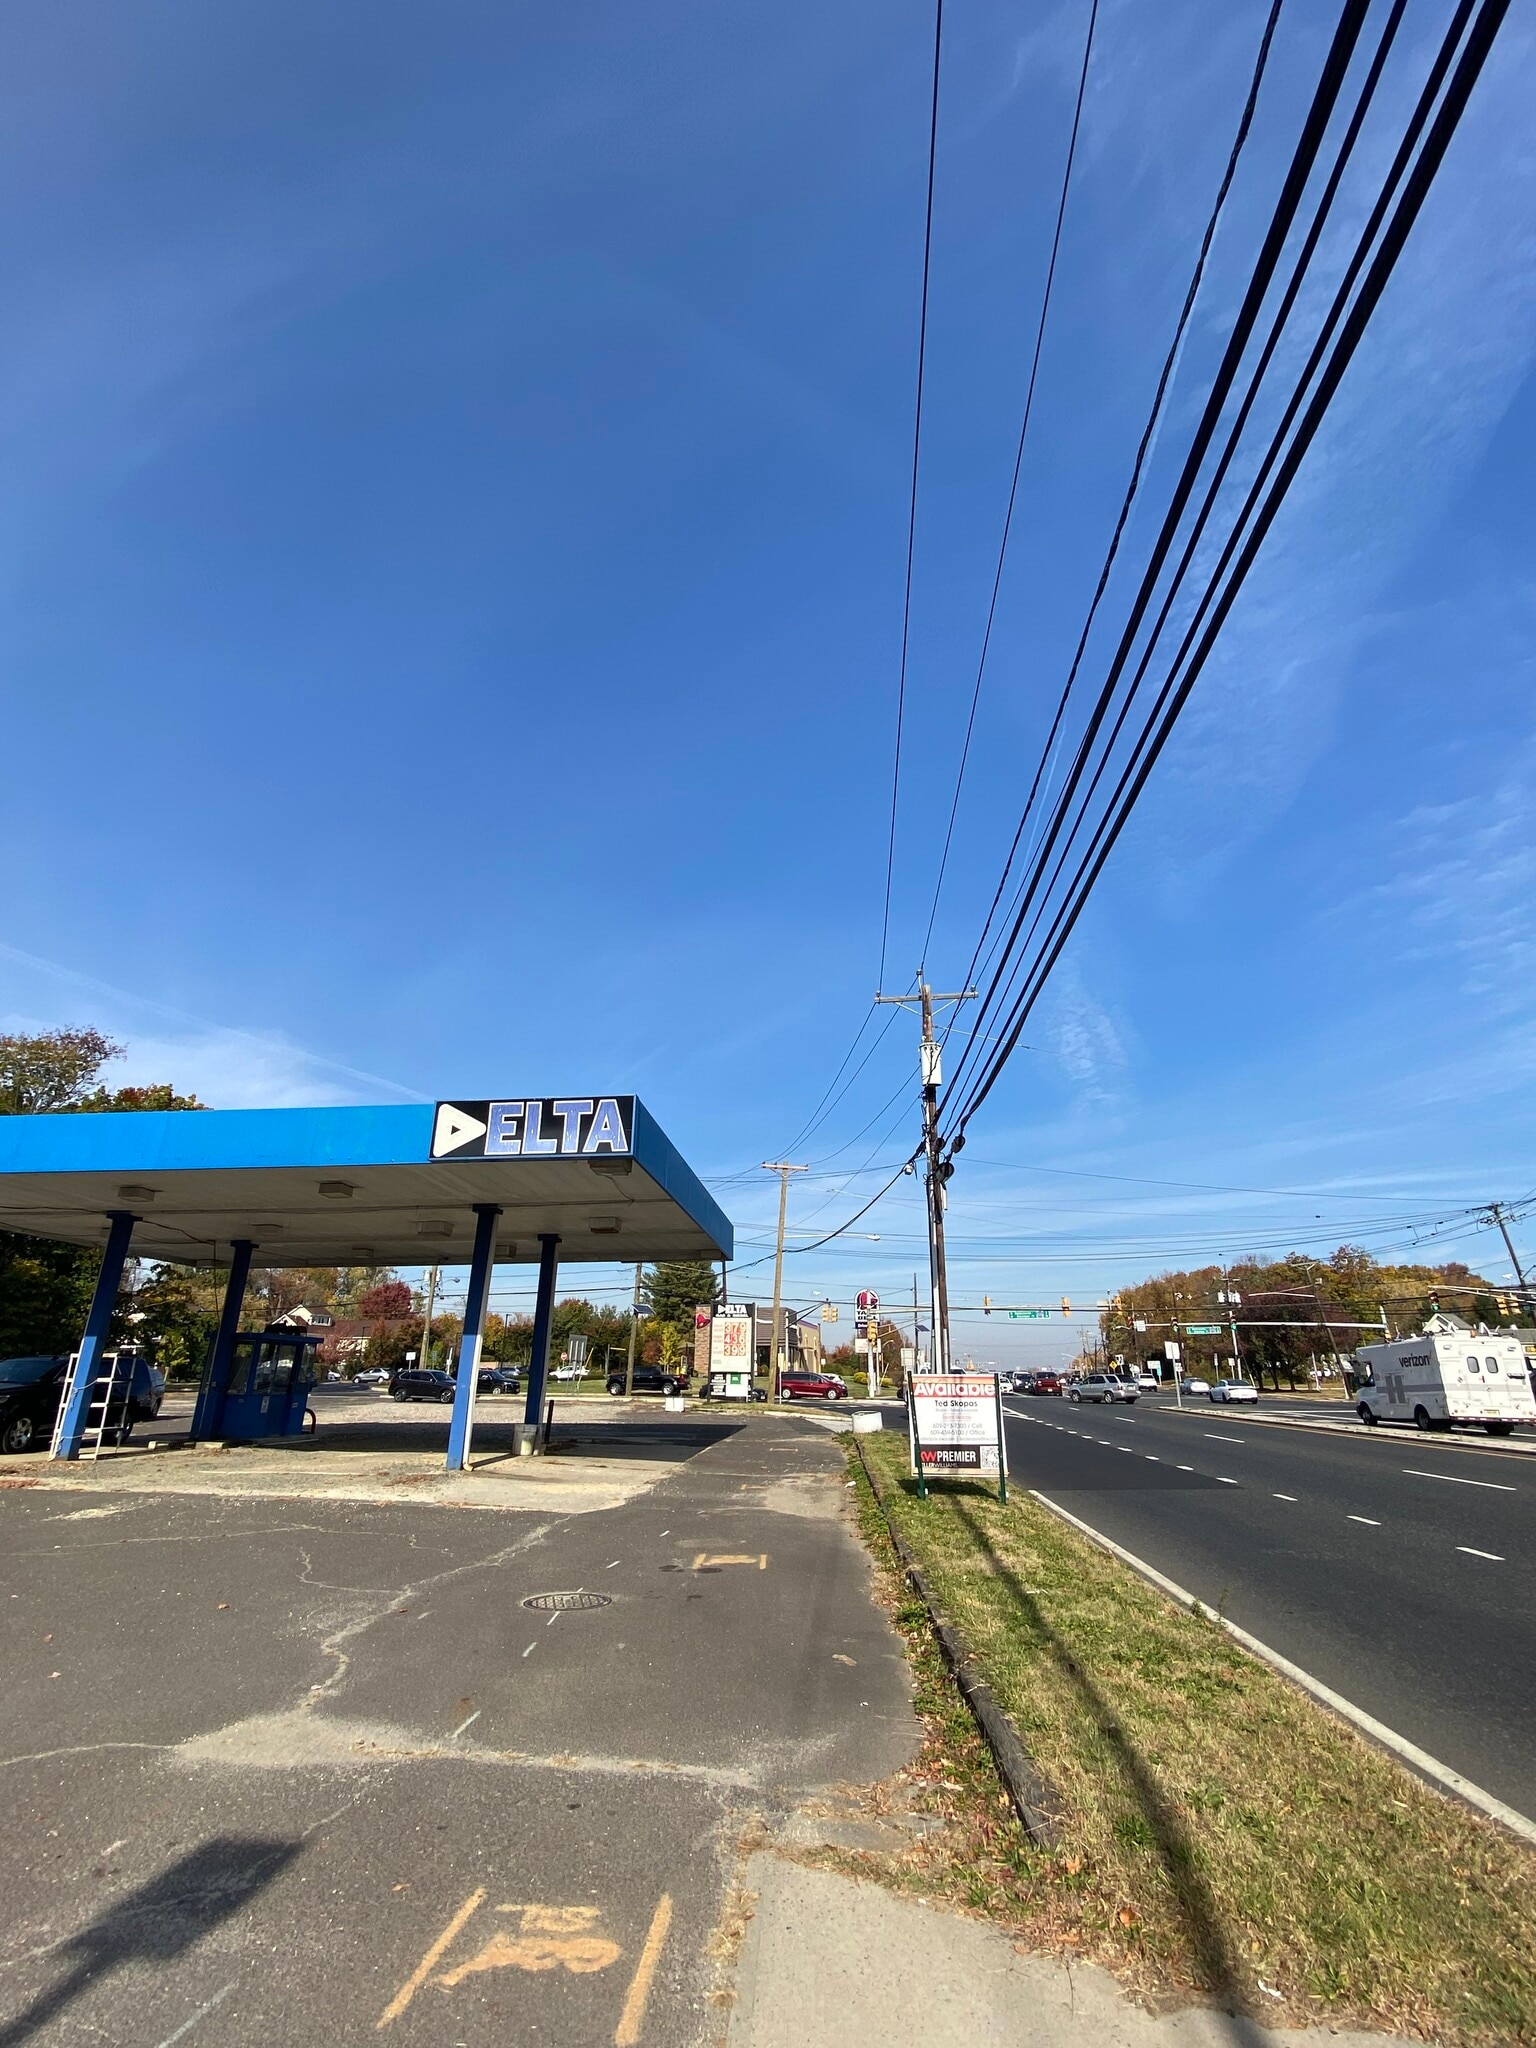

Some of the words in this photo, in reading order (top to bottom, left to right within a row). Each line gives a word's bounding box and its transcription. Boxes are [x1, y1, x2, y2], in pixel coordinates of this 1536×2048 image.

[724, 1322, 746, 1333] 379
[724, 1333, 746, 1344] 436
[724, 1345, 746, 1356] 399
[1398, 1352, 1431, 1368] verizon
[914, 1382, 995, 1396] Available
[950, 1400, 978, 1408] Skopas
[937, 1450, 977, 1462] PREMIER
